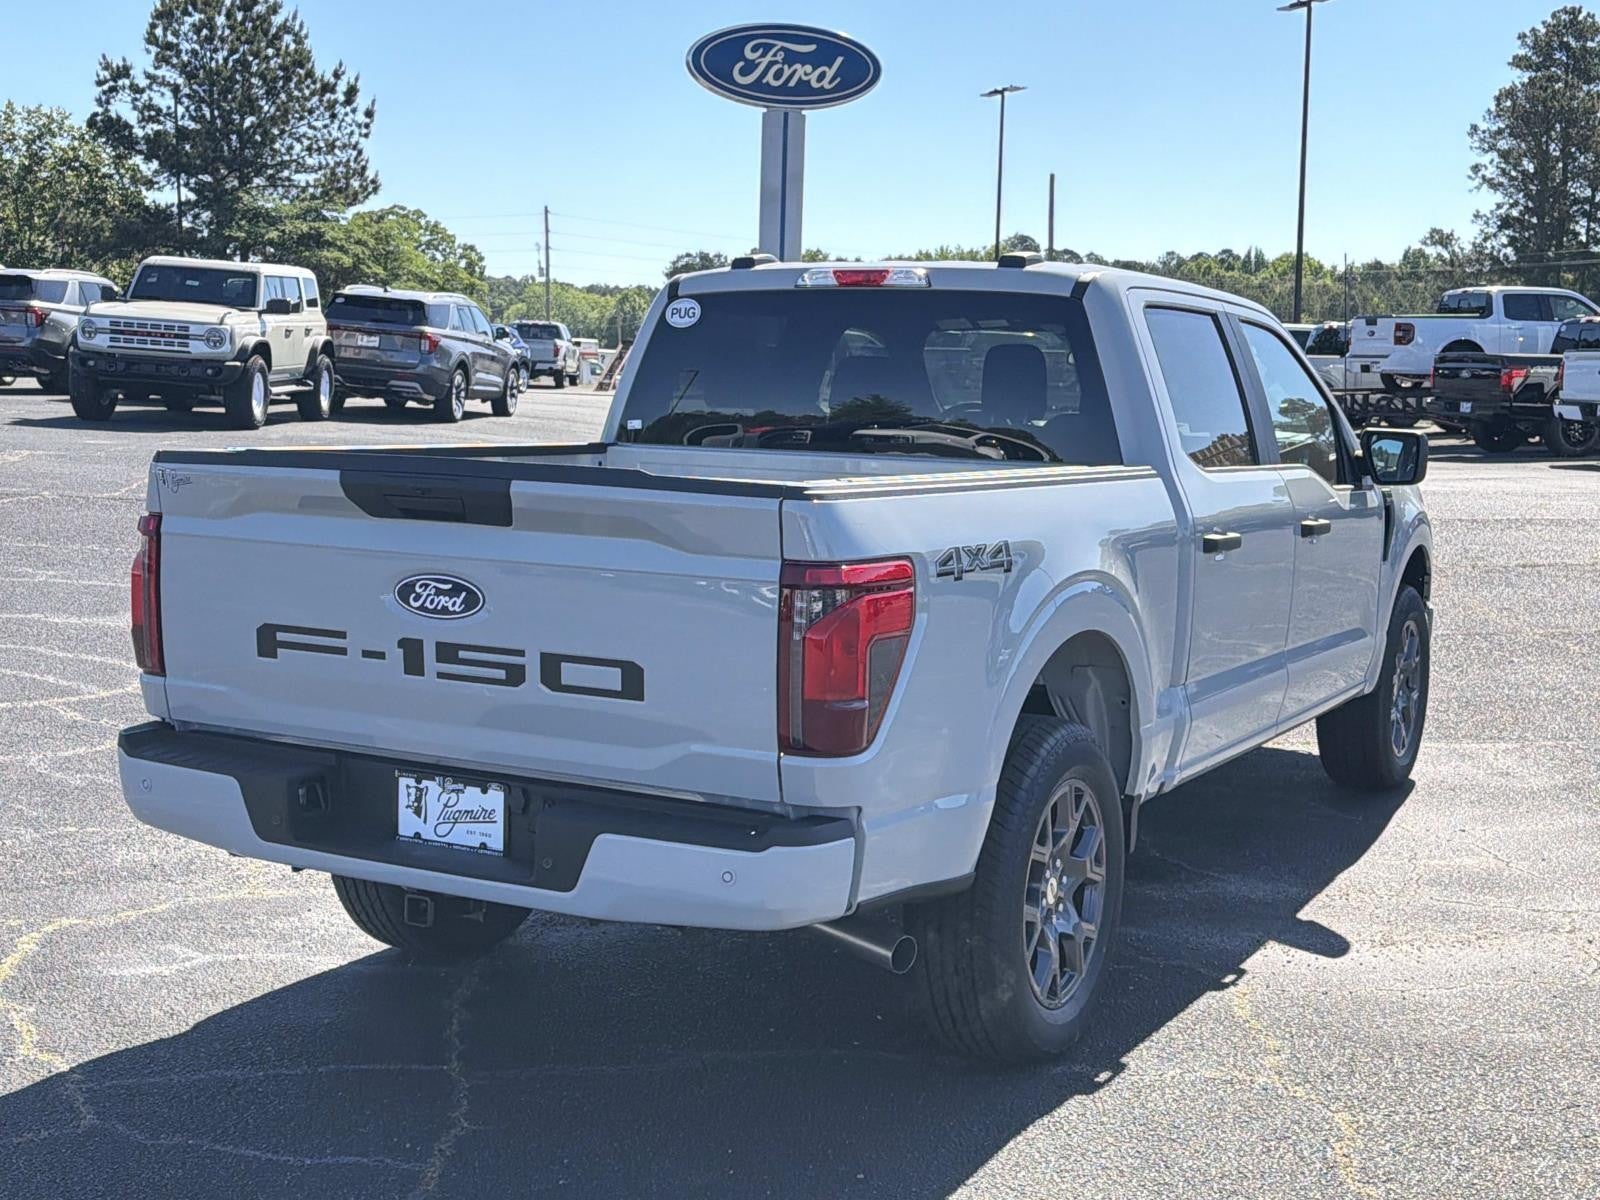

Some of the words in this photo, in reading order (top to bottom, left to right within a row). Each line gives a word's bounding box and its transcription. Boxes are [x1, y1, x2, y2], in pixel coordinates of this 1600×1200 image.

[732, 38, 845, 90] Ford
[670, 306, 697, 320] PUG
[409, 580, 467, 612] Ford
[256, 622, 645, 702] F-150
[434, 788, 498, 838] Pugmire
